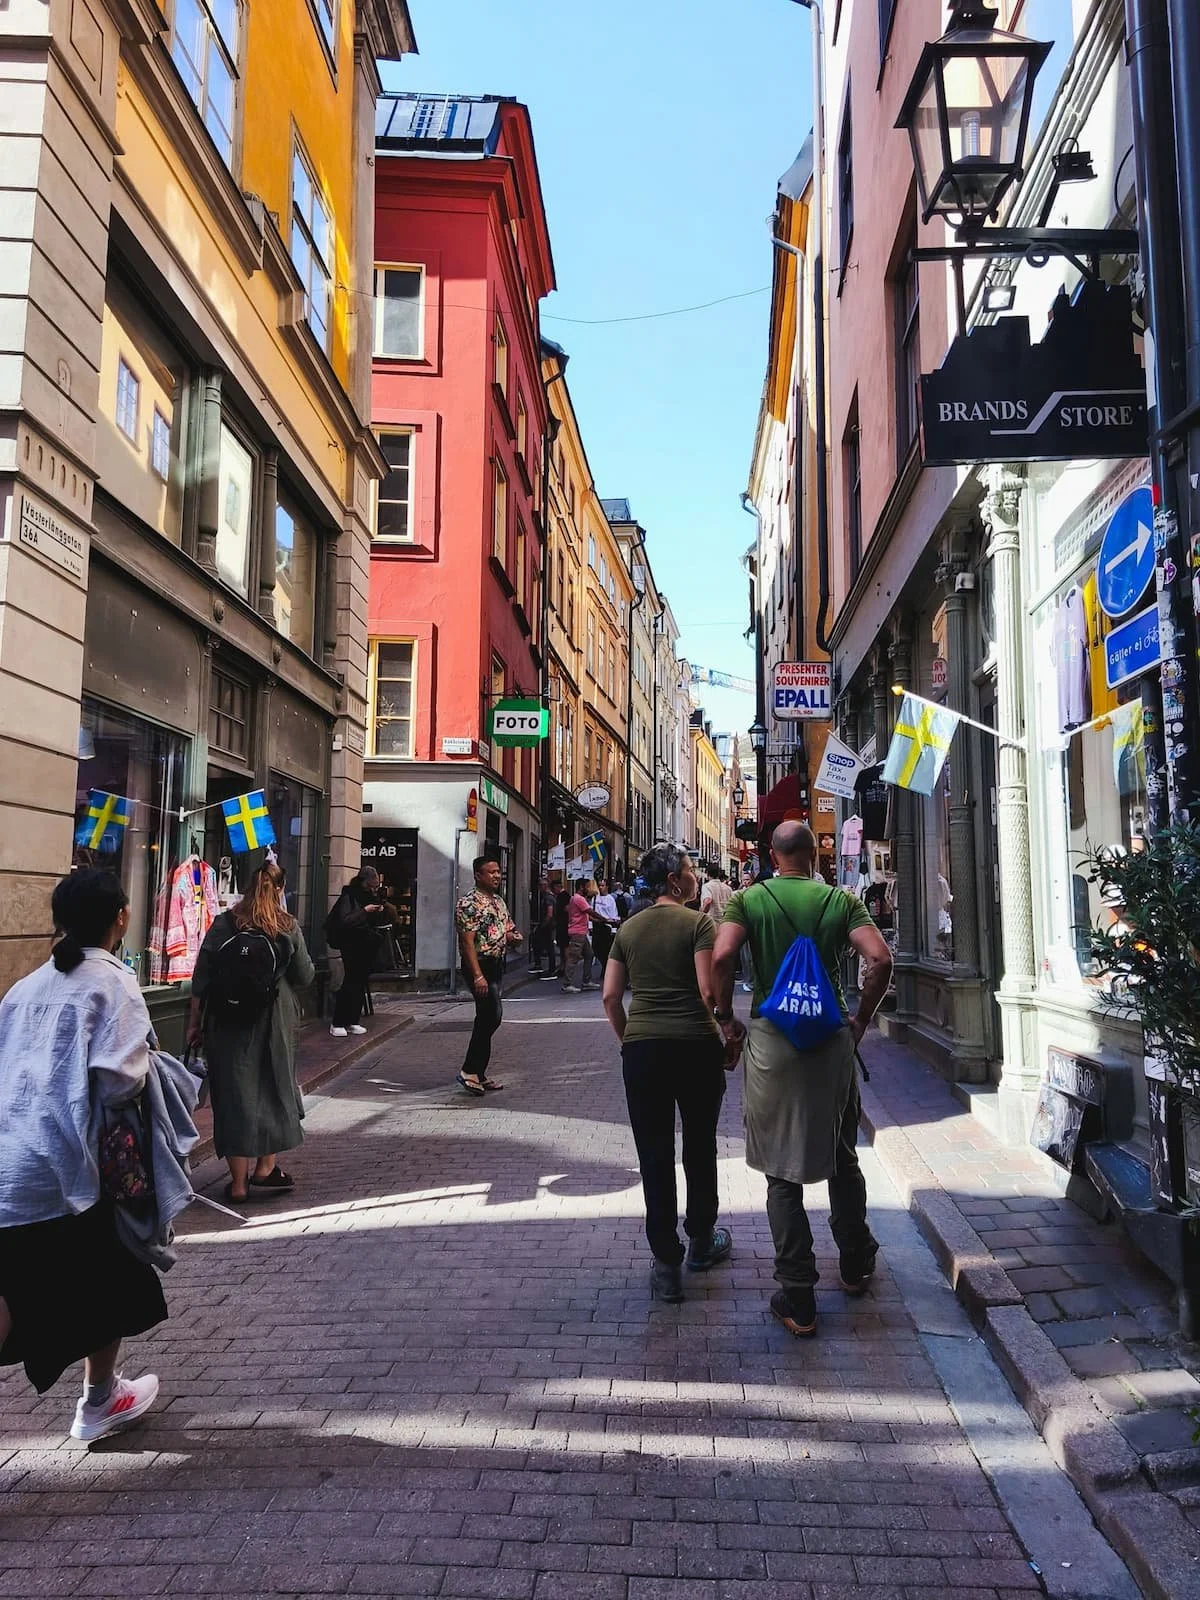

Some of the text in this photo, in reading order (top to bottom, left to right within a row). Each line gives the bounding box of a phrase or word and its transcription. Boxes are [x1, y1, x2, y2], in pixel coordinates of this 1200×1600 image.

[939, 400, 1133, 427] BRANDS STORE
[24, 524, 38, 544] 36A
[1109, 637, 1142, 665] Gäller ej
[780, 664, 827, 674] PRESENTER
[776, 676, 830, 686] SOUVENIRER
[776, 689, 830, 708] EPALL
[496, 717, 539, 729] FOTO
[828, 763, 843, 773] Tax
[827, 771, 847, 782] Free
[379, 846, 397, 857] AB
